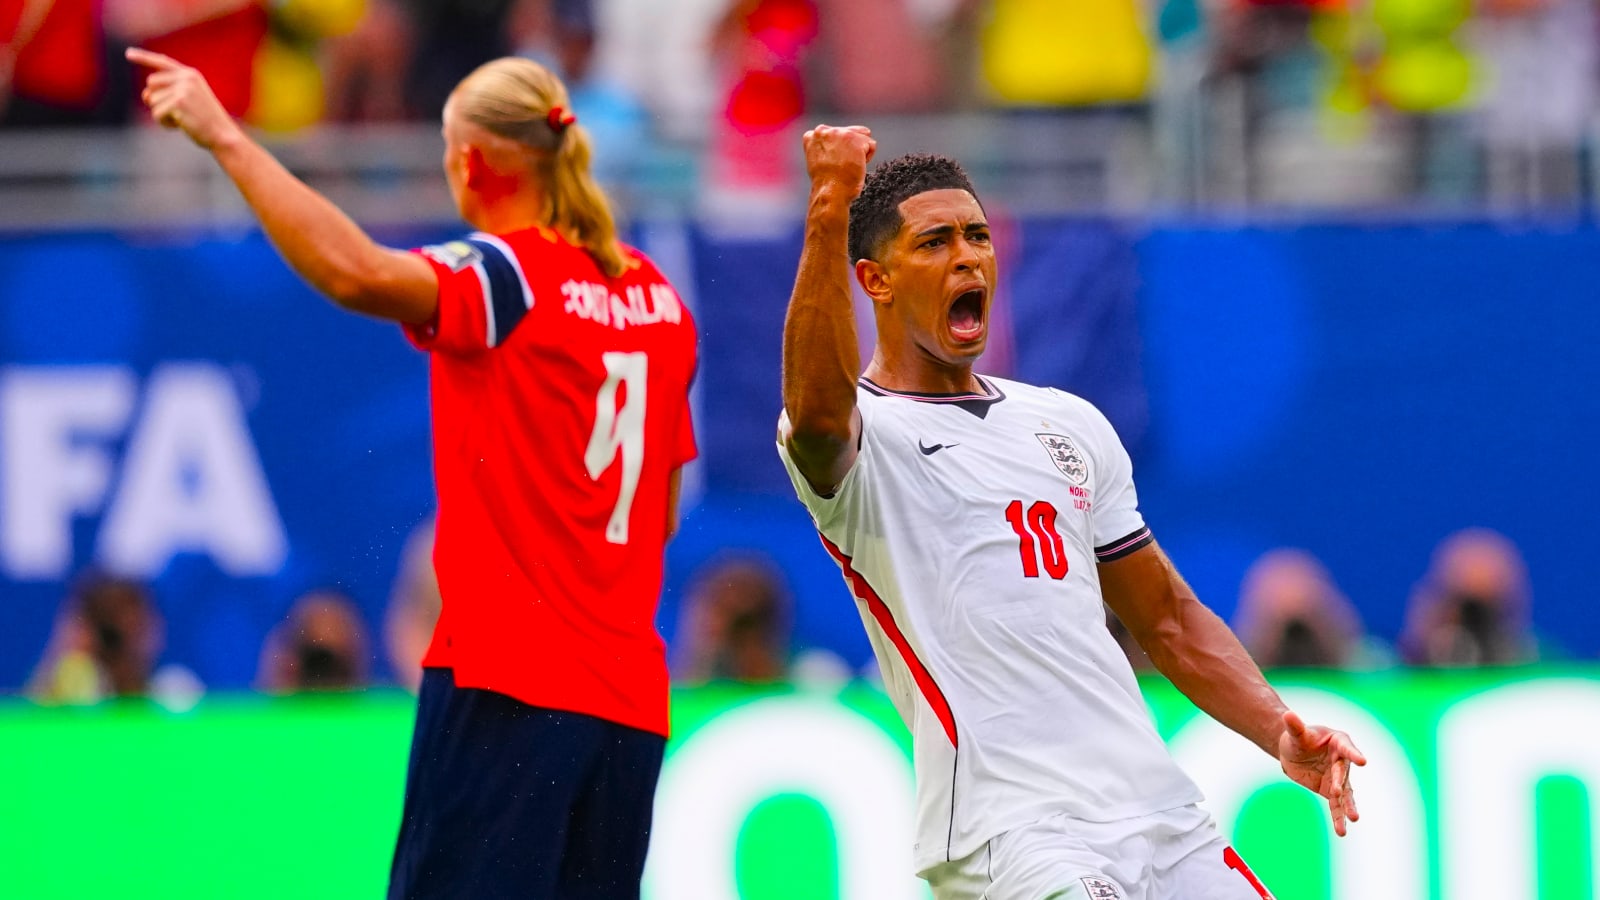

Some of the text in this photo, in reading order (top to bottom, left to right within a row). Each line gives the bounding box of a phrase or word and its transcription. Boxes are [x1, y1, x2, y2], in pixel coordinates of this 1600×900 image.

[584, 351, 649, 544] 9
[1069, 485, 1089, 498] NOR
[1005, 500, 1068, 581] 10
